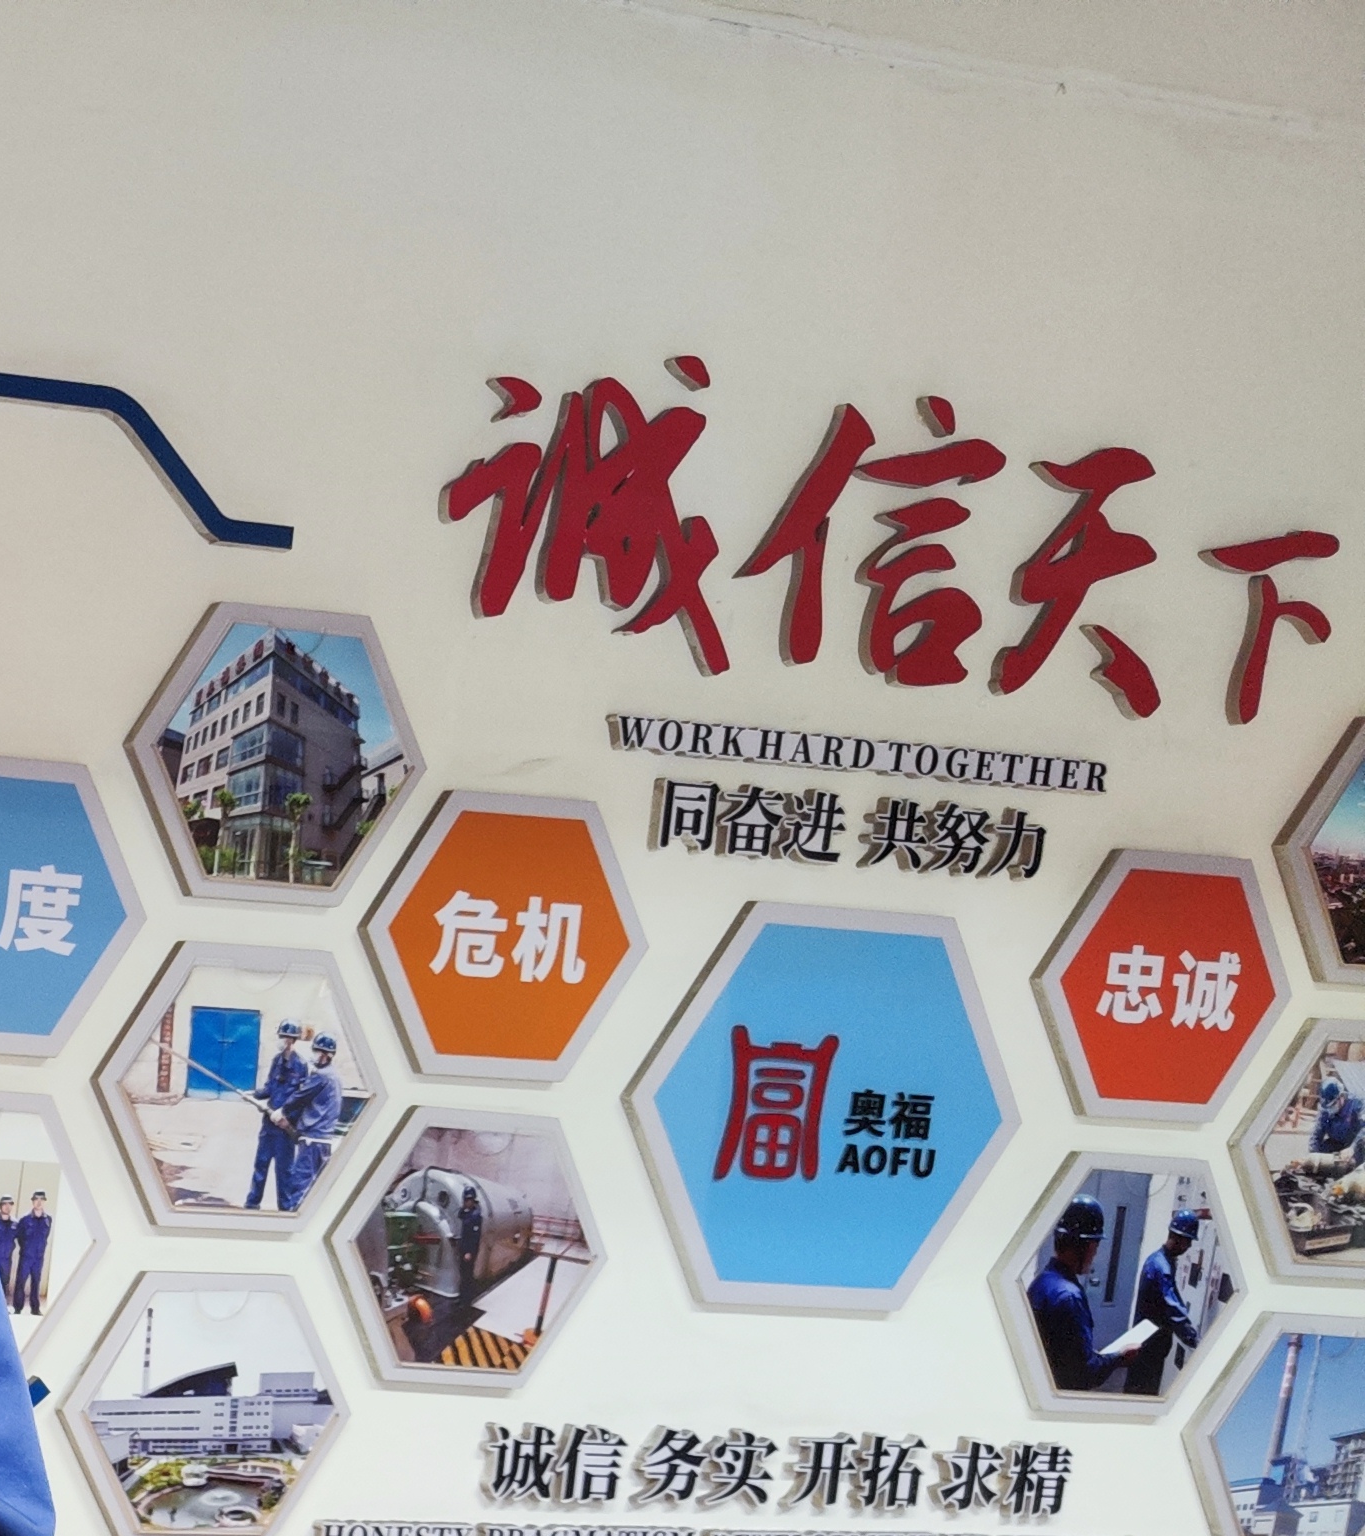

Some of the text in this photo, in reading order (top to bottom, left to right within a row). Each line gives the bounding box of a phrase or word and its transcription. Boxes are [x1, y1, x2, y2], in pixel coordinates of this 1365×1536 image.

[441, 353, 1341, 726] 诚信天下
[619, 716, 1109, 793] WORK HARD TOGETHER
[660, 780, 1047, 880] 同奋进 共努力
[429, 890, 587, 984] 危机
[1096, 944, 1243, 1032] 忠诚
[844, 1089, 936, 1141] 奥福
[837, 1142, 936, 1179] AOFU
[489, 1425, 1074, 1515] 诚信 务实 开拓 求精
